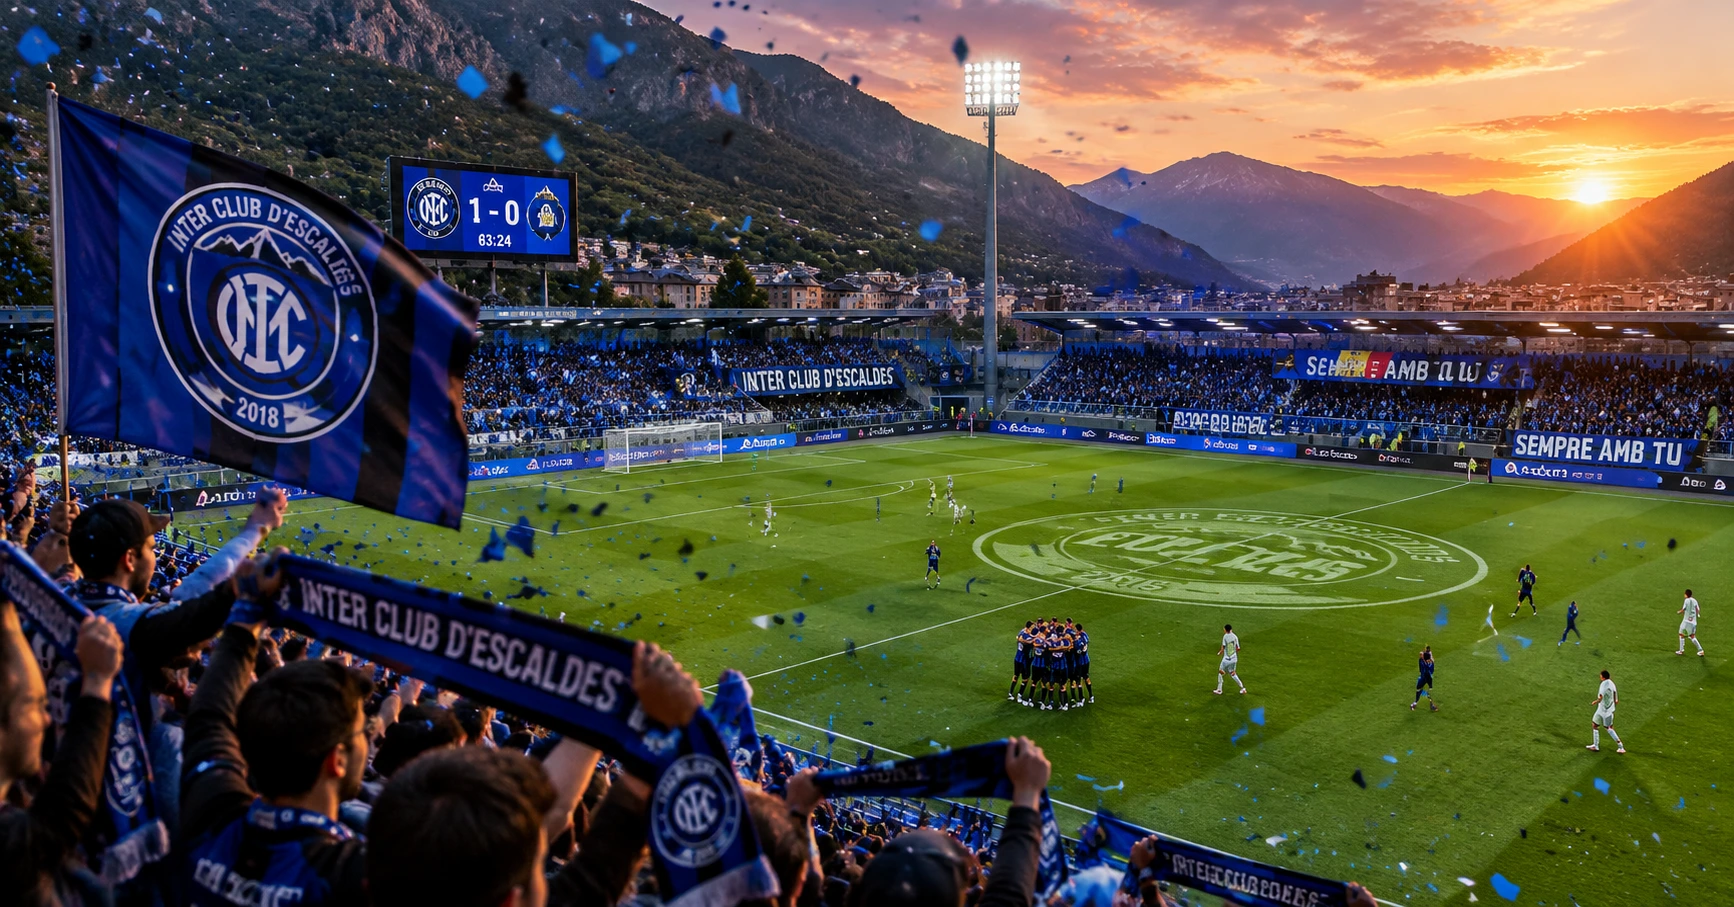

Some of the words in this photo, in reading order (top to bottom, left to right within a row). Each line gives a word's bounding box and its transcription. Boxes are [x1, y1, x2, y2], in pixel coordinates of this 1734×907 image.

[167, 203, 213, 254] INTER
[211, 195, 262, 219] CLUB
[469, 197, 481, 224] 1
[504, 200, 520, 226] 0
[742, 370, 786, 392] INTER
[788, 368, 821, 390] CLUB
[824, 366, 895, 388] D'ESCALDES
[1383, 359, 1430, 382] AMB
[236, 396, 280, 428] 2018
[1515, 433, 1594, 460] SEMPRE
[1598, 437, 1646, 464] AMB
[1653, 441, 1683, 466] TU
[299, 577, 368, 632] INTER
[374, 600, 441, 651] CLUB
[445, 619, 624, 714] D'ESCALDES
